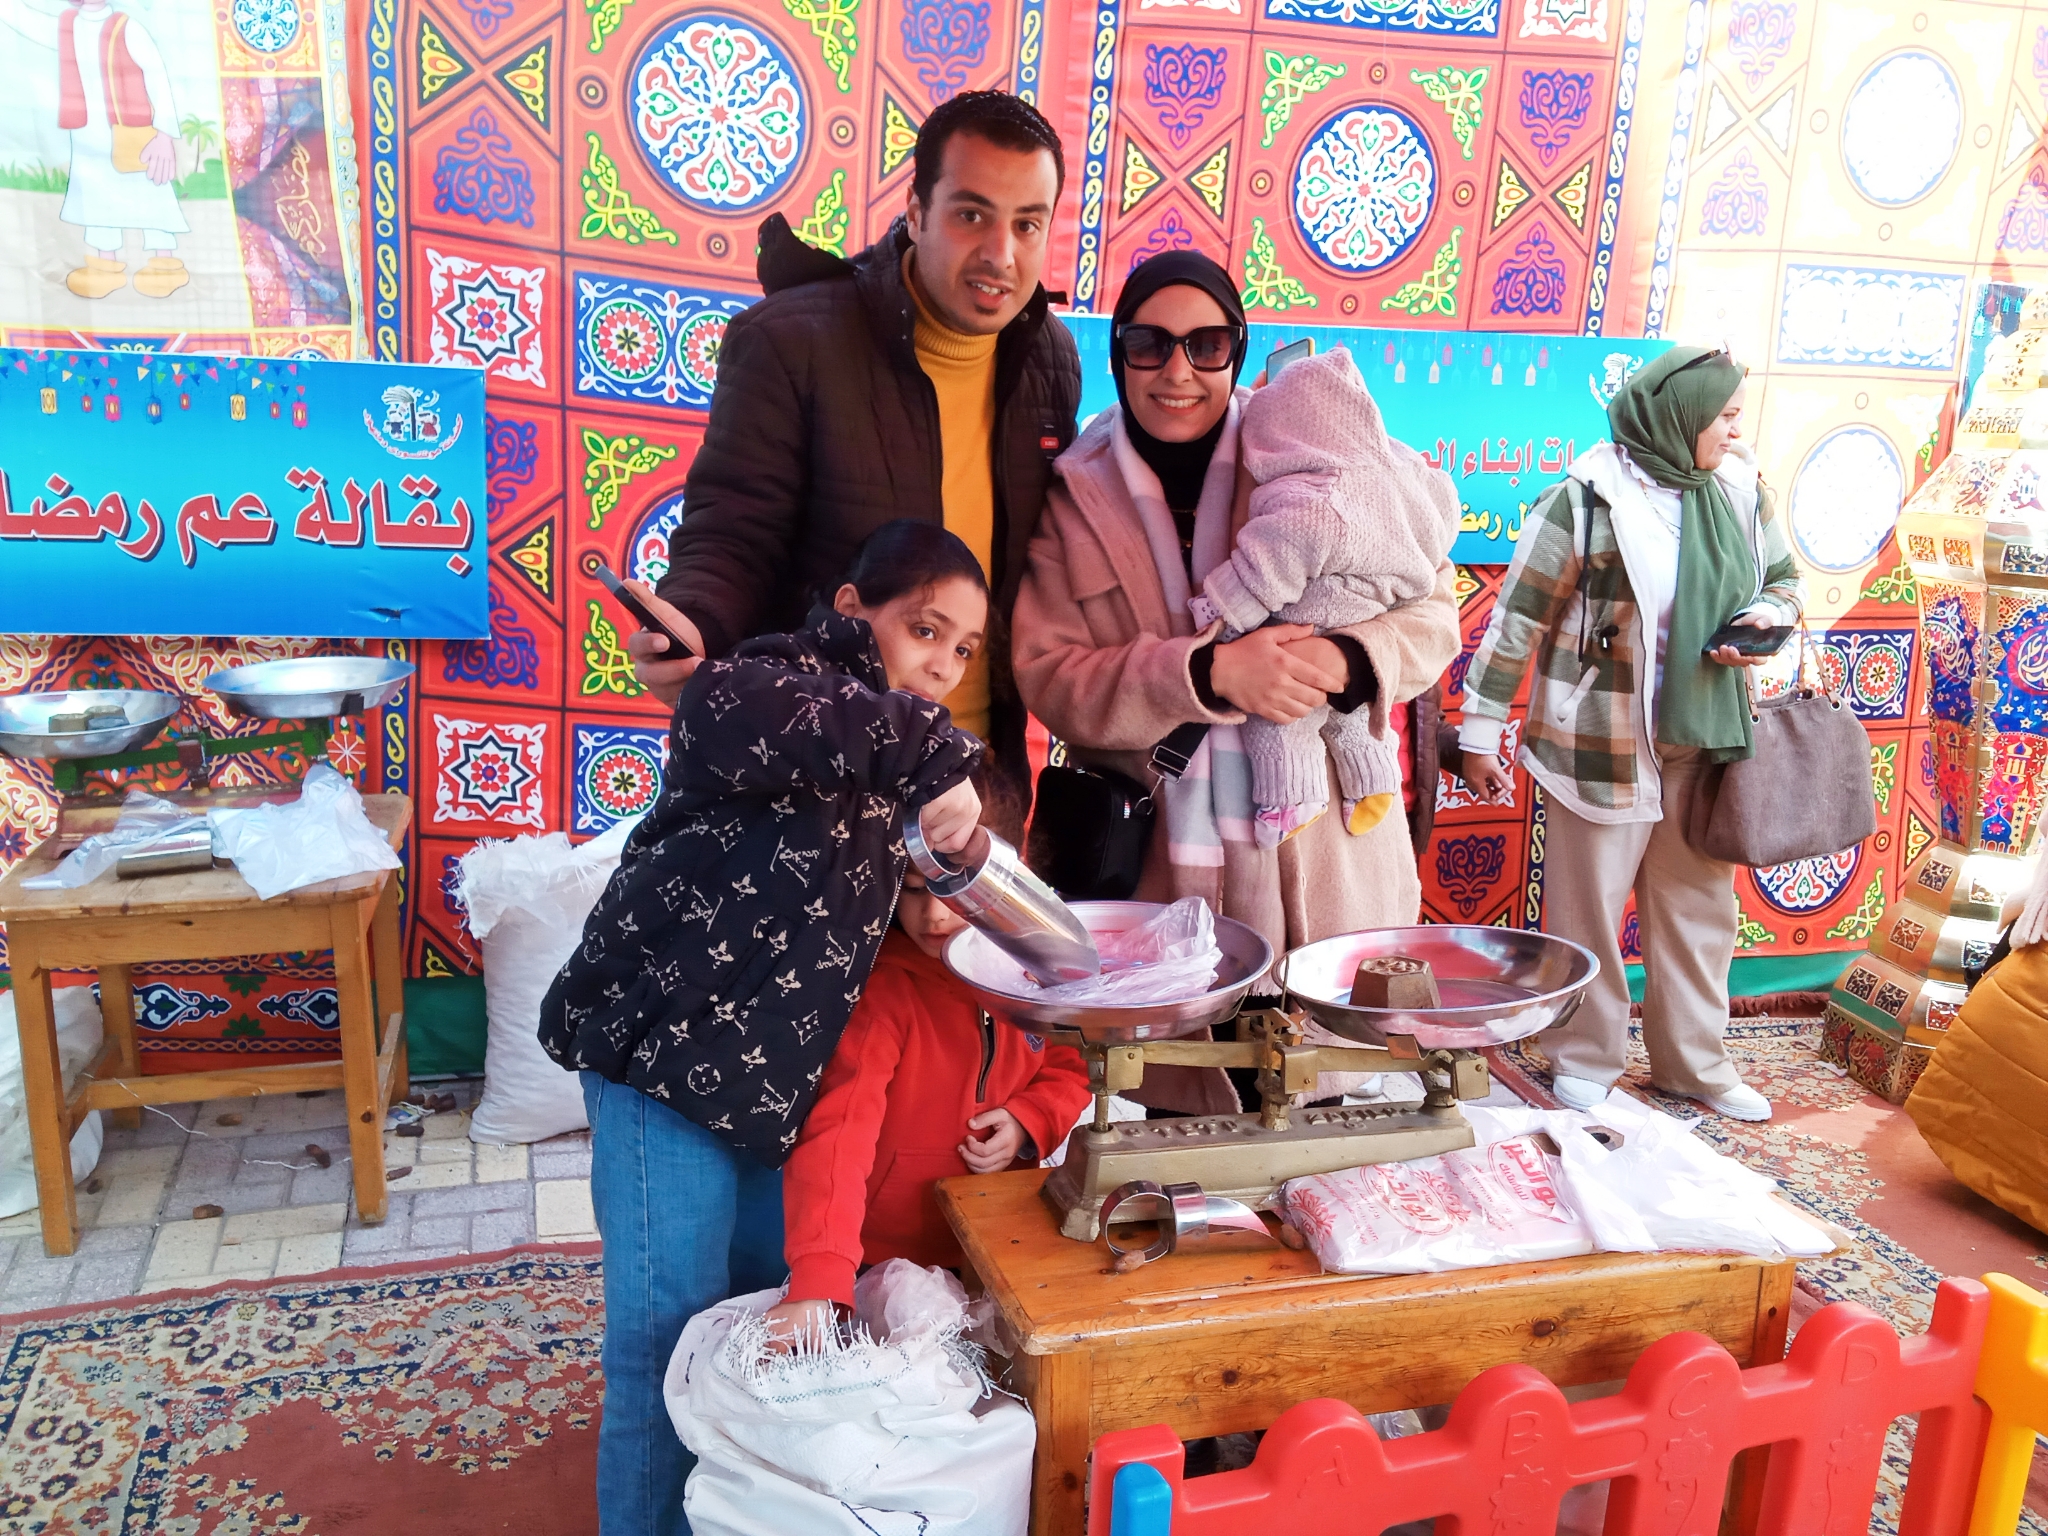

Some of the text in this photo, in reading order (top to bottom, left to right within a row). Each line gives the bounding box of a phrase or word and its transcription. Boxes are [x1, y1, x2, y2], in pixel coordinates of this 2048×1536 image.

[1462, 436, 1534, 488] ابناء
[0, 466, 472, 577] بقالة عم رمضا
[1458, 502, 1503, 541] رمض
[1501, 1410, 1544, 1460] B
[1668, 1371, 1713, 1421] C
[1840, 1343, 1878, 1386] D
